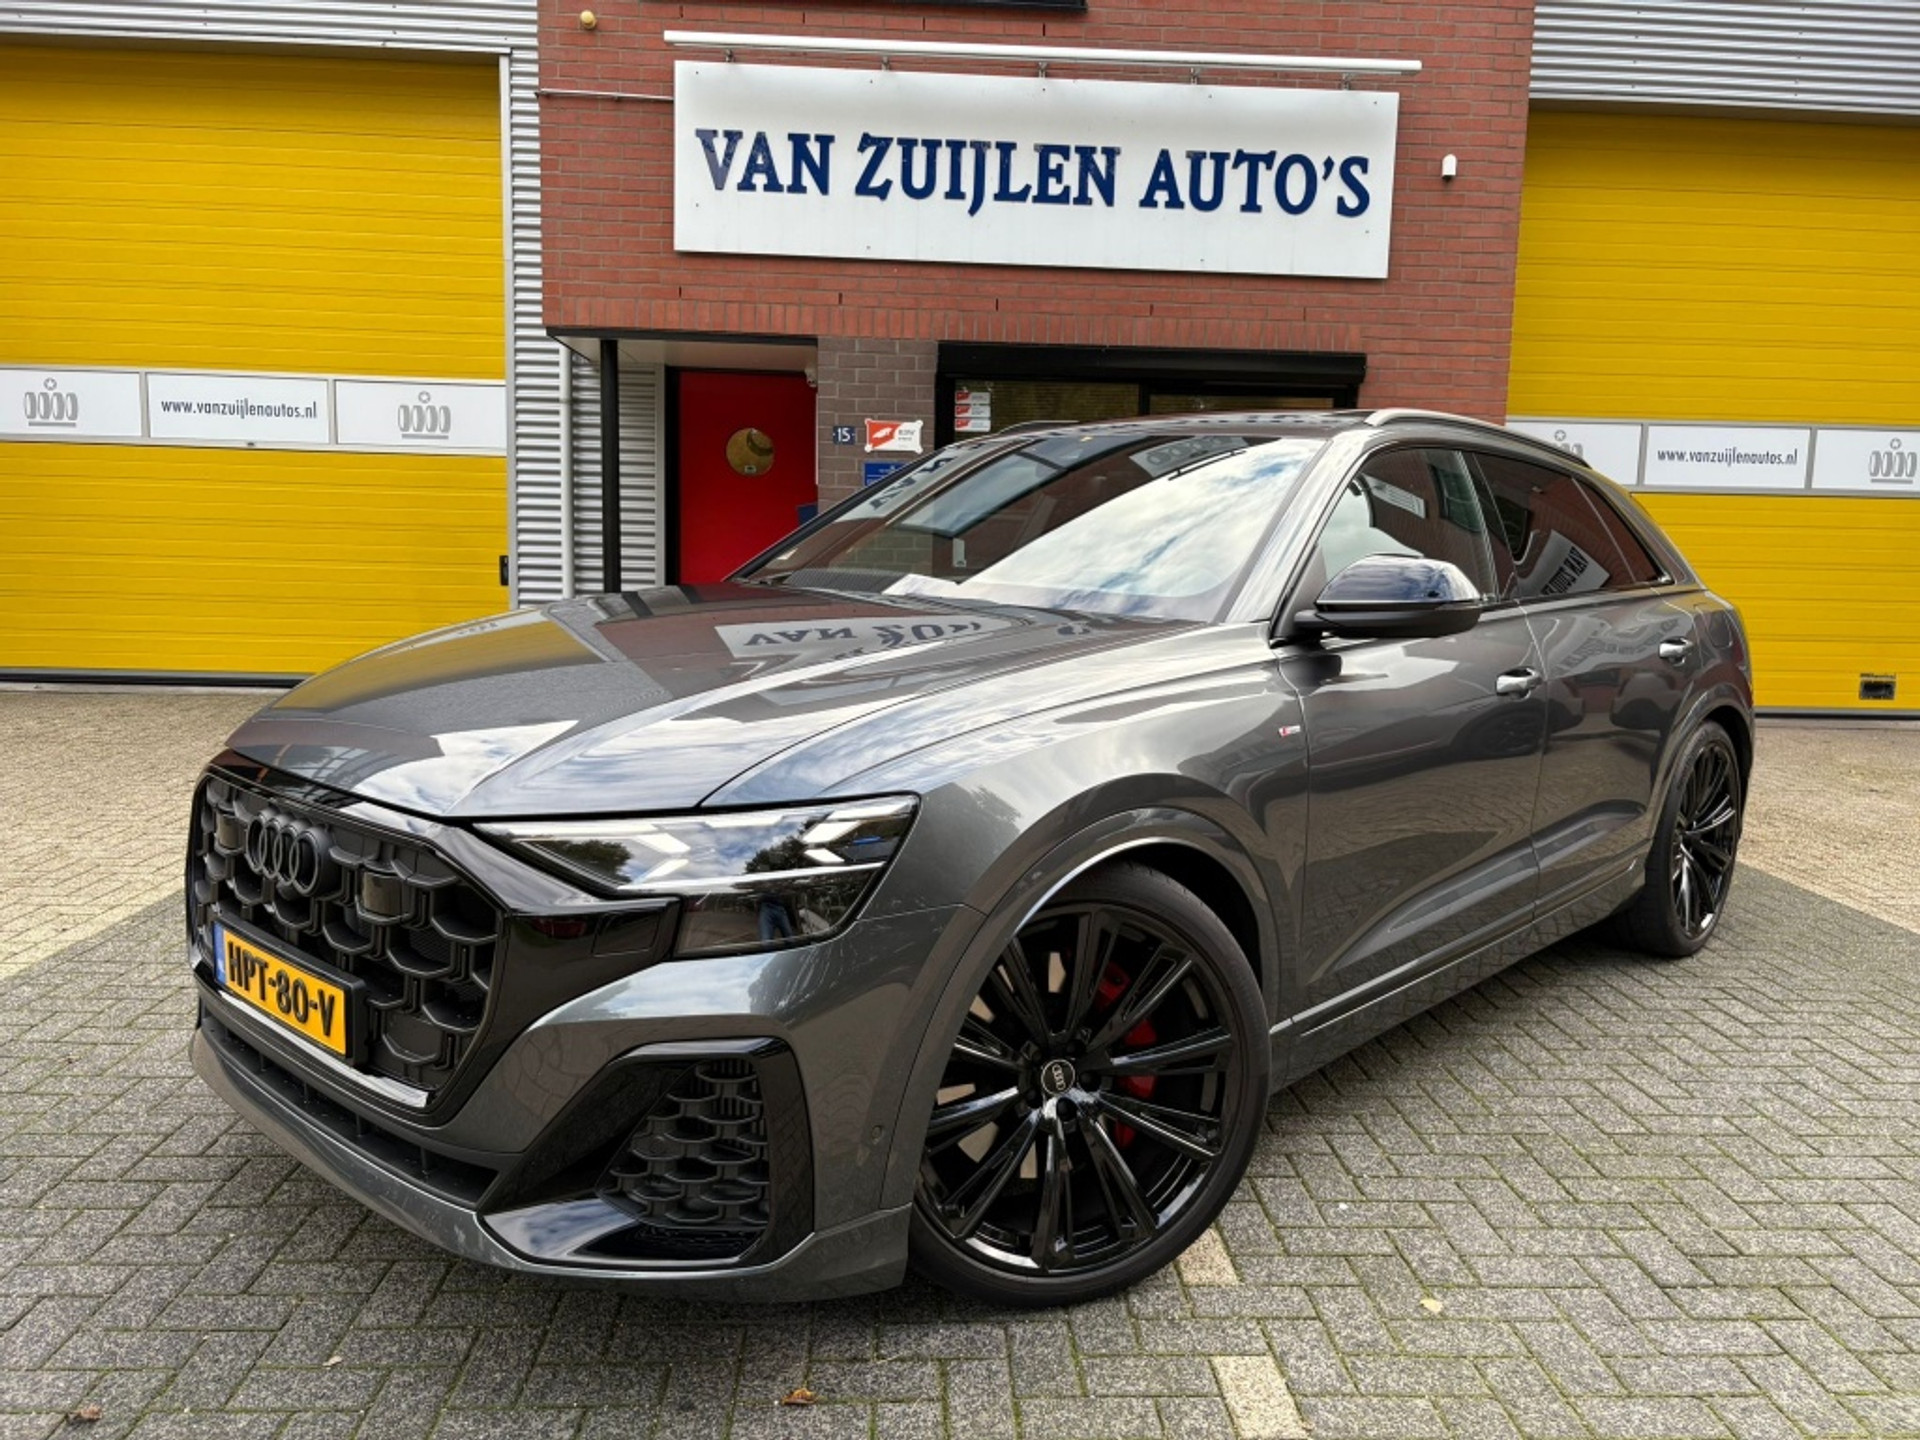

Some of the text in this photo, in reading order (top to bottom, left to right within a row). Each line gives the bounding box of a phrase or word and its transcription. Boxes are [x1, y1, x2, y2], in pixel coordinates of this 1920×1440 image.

[695, 129, 1370, 218] VAN ZUIJLEN AUTO'S
[160, 397, 318, 420] www.vanzuijlenautos.nl
[837, 427, 851, 442] 15
[1657, 446, 1798, 468] www.vanzuijlenautos.nl
[227, 941, 336, 1037] HPT-80-V
